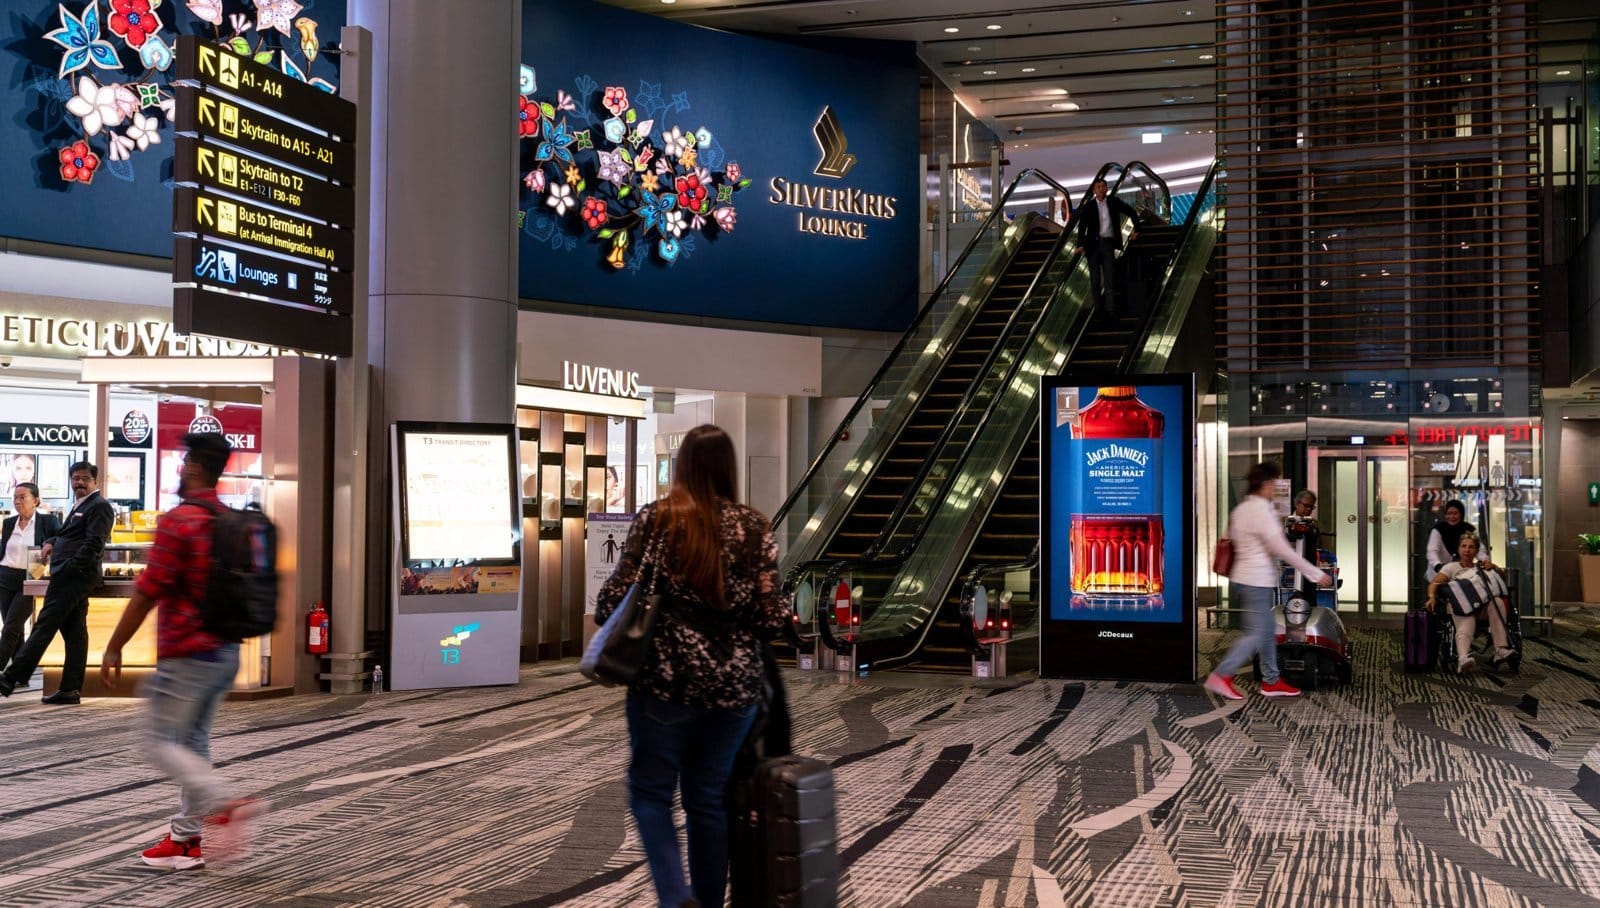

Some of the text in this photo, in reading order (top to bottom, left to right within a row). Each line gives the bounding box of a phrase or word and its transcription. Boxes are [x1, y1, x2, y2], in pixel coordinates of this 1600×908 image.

[242, 70, 254, 88] A1
[263, 80, 282, 98] A14
[241, 118, 279, 145] Skytrain
[281, 134, 291, 149] to
[292, 139, 310, 156] A15
[317, 148, 334, 164] A21
[240, 159, 304, 192] Skytrain to T2
[769, 176, 898, 219] SILVERKRIS
[240, 206, 312, 238] Bus to Terminal 4
[799, 212, 868, 240] LOUNGE
[240, 226, 334, 262] (at Arrival Immigration Hall A)
[240, 262, 278, 286] Lounges
[564, 360, 639, 398] LUVENUS
[11, 426, 88, 443] LANCÔM
[225, 434, 255, 449] SK-II
[1086, 444, 1148, 466] JACK DANIEL'S
[441, 648, 460, 664] T3
